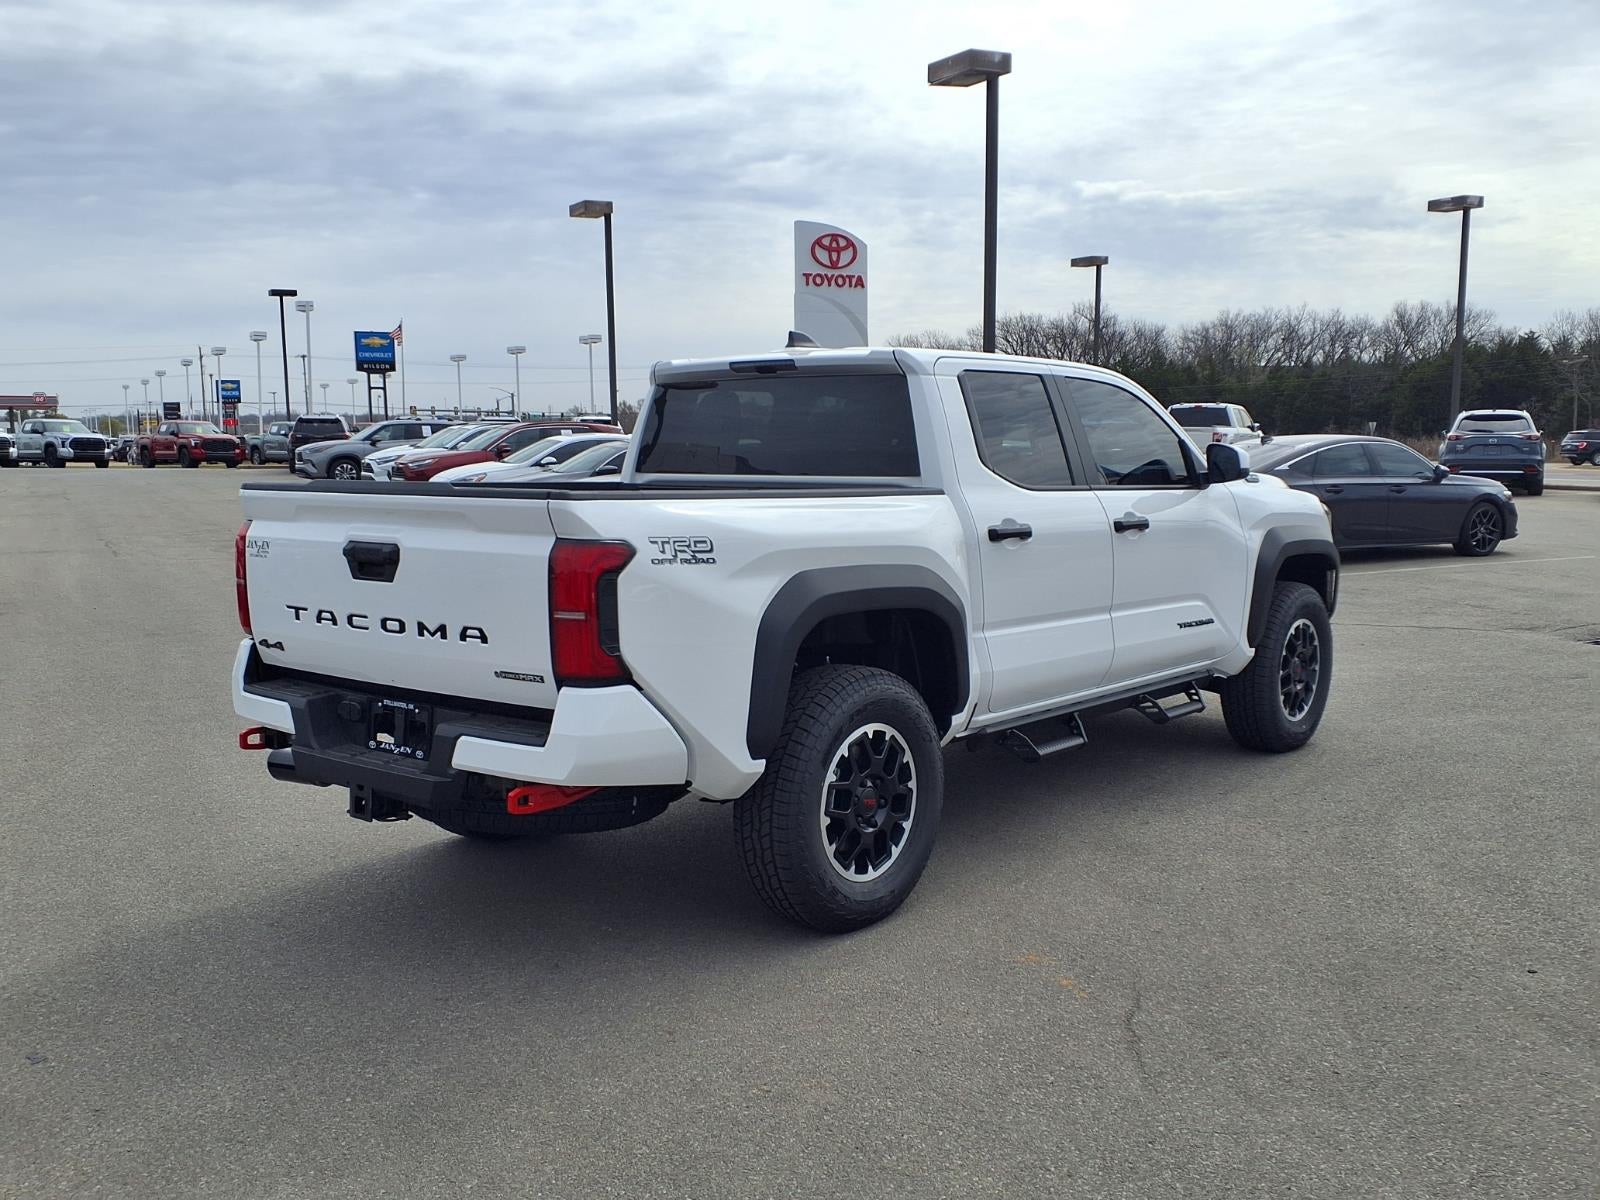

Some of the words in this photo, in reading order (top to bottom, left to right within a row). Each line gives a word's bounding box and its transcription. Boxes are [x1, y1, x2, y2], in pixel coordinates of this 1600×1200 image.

[803, 272, 865, 288] TOYOTA
[648, 536, 714, 558] TRD
[680, 557, 717, 565] ROAD
[286, 604, 489, 645] TACOMA
[380, 742, 412, 754] JANZEN
